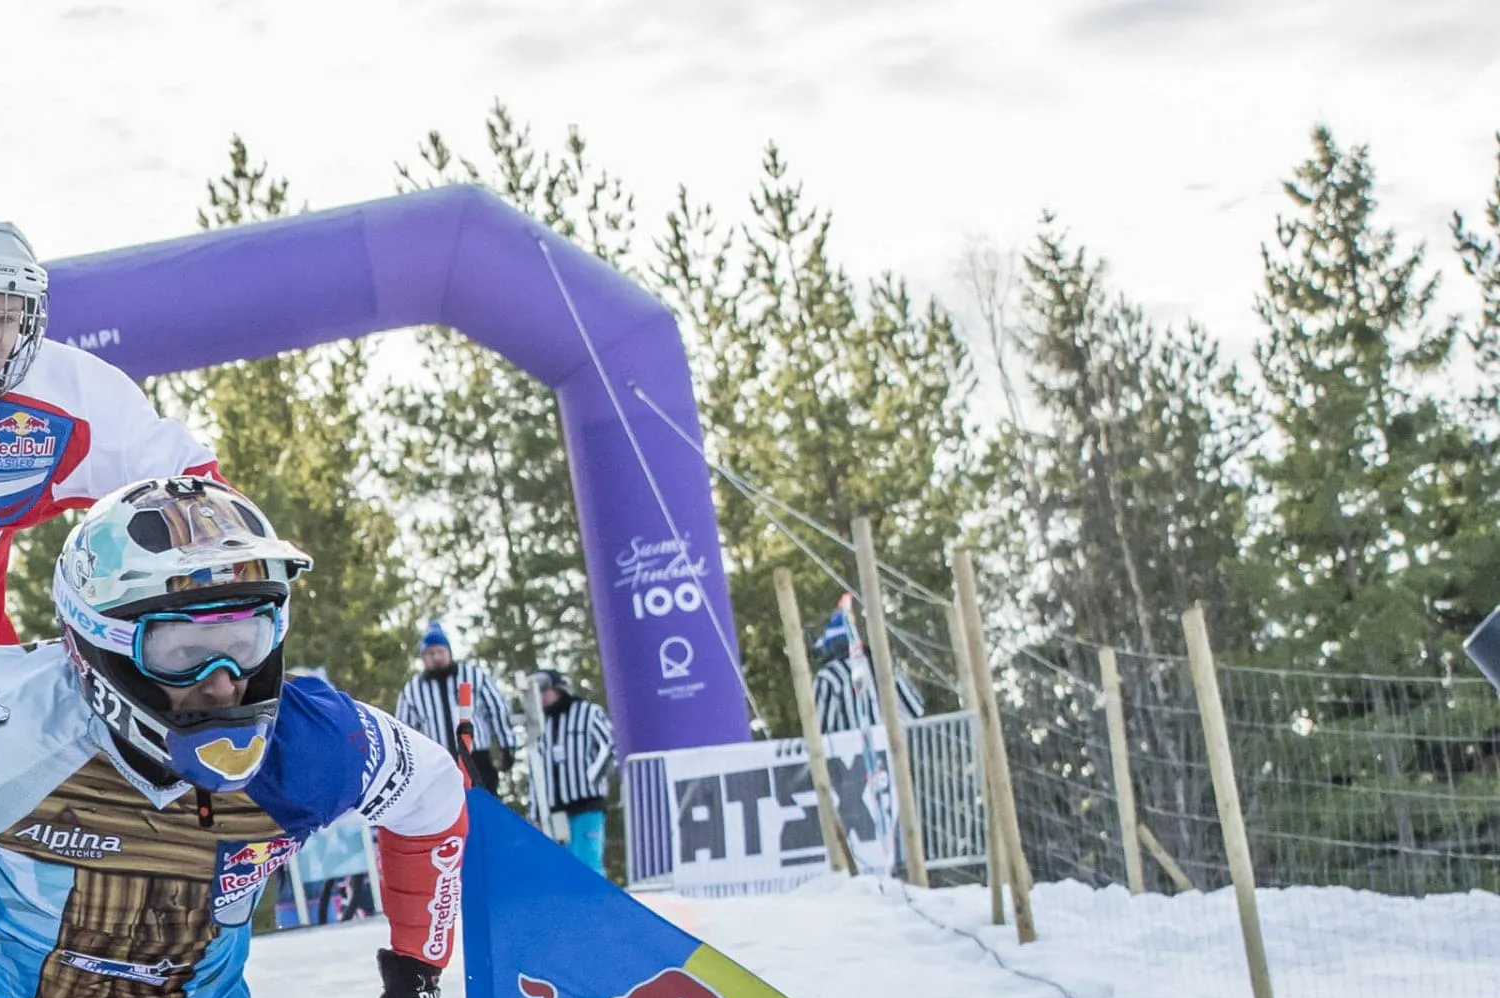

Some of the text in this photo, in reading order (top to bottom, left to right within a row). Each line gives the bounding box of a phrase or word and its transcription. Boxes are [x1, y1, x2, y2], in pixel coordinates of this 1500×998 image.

[21, 436, 56, 457] Bull
[632, 581, 703, 620] 100
[91, 679, 123, 731] 32
[14, 823, 122, 853] Alpina
[55, 848, 103, 859] WATCHES
[219, 841, 302, 894] Red Bull
[428, 876, 452, 956] Carrefour
